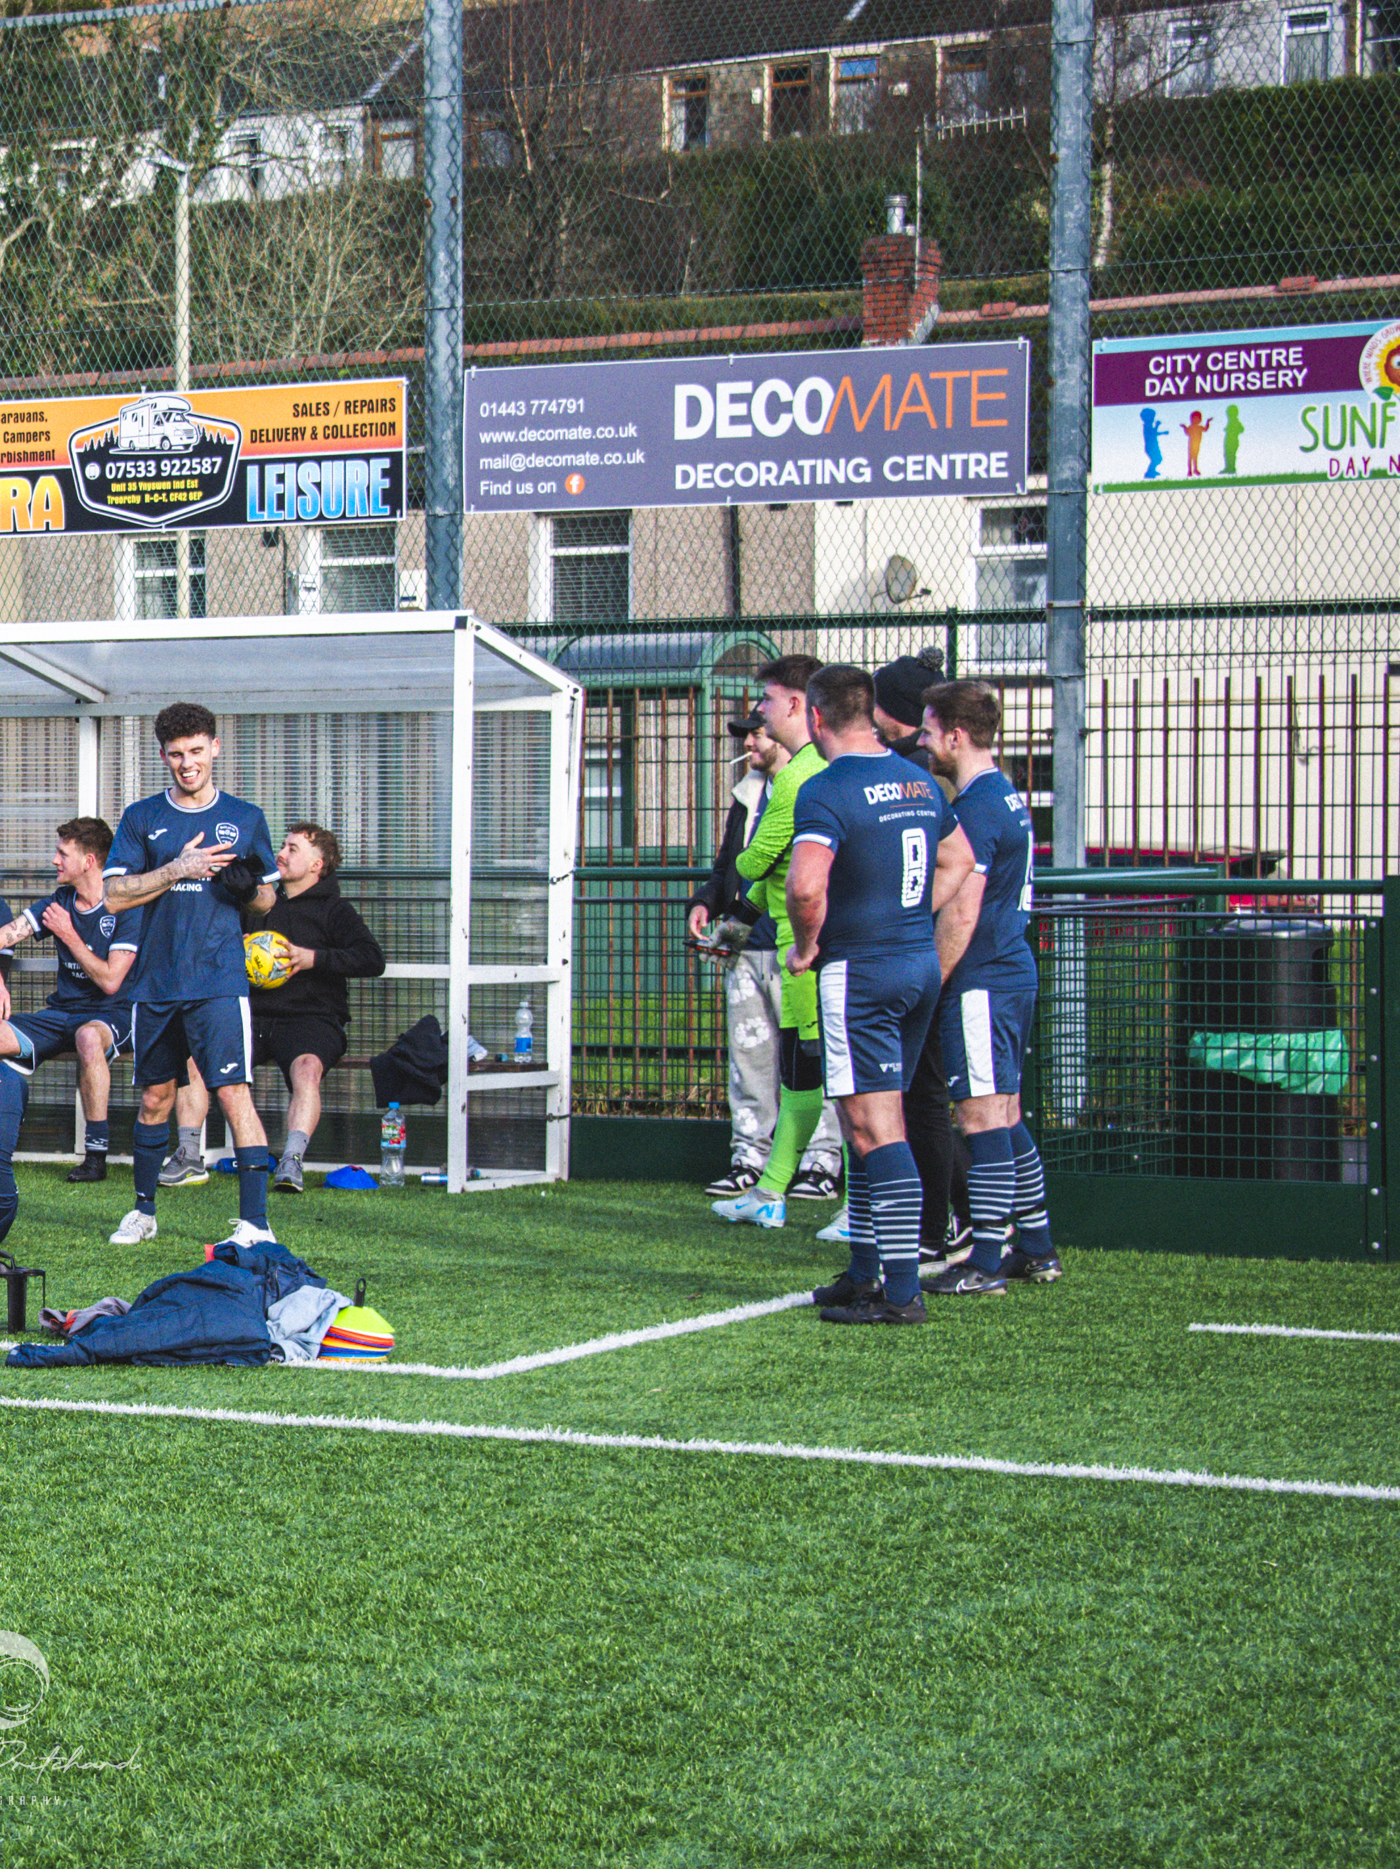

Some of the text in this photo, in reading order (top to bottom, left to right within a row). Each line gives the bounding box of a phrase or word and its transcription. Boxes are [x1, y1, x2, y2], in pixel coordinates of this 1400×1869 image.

[1148, 347, 1304, 375] CITY CENTRE
[1144, 367, 1308, 397] DAY NURSERY
[292, 401, 330, 418] SALES
[344, 397, 396, 415] REPAIRS
[479, 398, 585, 418] 01443 774791
[673, 368, 1009, 441] DECOMATE
[3, 430, 51, 444] Campers
[250, 421, 396, 444] DELIVERY & COLLECTION
[479, 422, 638, 444] www.decomate.co.uk
[105, 457, 222, 480] 07533 922587
[479, 448, 645, 472] mail@decomate.co.uk
[674, 451, 1009, 491] DECORATING CENTRE
[1329, 456, 1371, 478] DAY
[111, 479, 199, 493] Unit 35 Ynyswen Ind Est
[246, 458, 391, 522] LEISURE
[480, 480, 512, 496] Find
[516, 482, 534, 494] us
[537, 481, 557, 494] on
[107, 494, 141, 505] Treorchy
[169, 492, 188, 502] CF42
[863, 780, 935, 805] DECOMATE
[879, 809, 937, 823] DECORATING CENTRE
[170, 882, 203, 892] RACING
